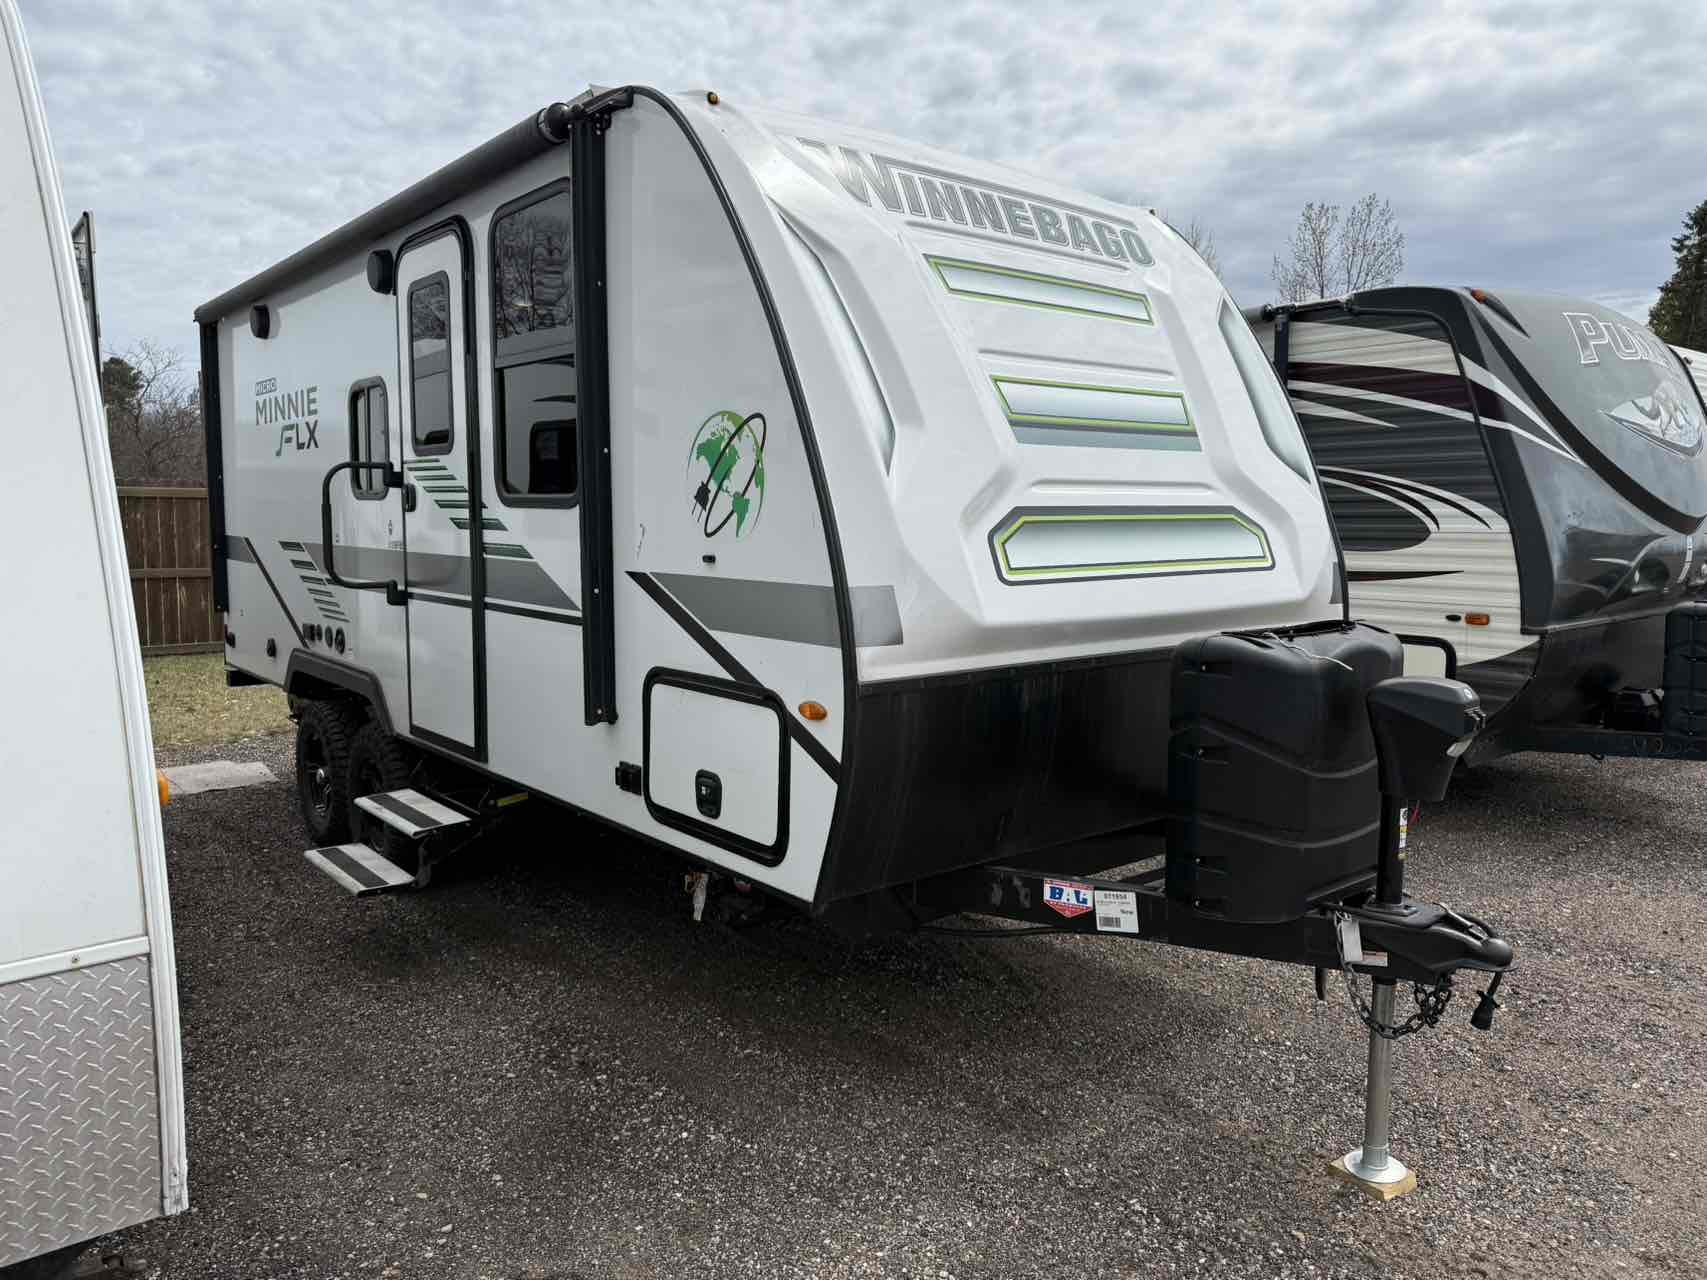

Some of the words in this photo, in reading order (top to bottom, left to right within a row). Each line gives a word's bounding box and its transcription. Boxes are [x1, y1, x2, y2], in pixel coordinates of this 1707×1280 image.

[796, 136, 1156, 266] WINNEBAGO
[1562, 311, 1677, 371] PU
[255, 386, 318, 426] MINNIE
[275, 419, 319, 457] FLX
